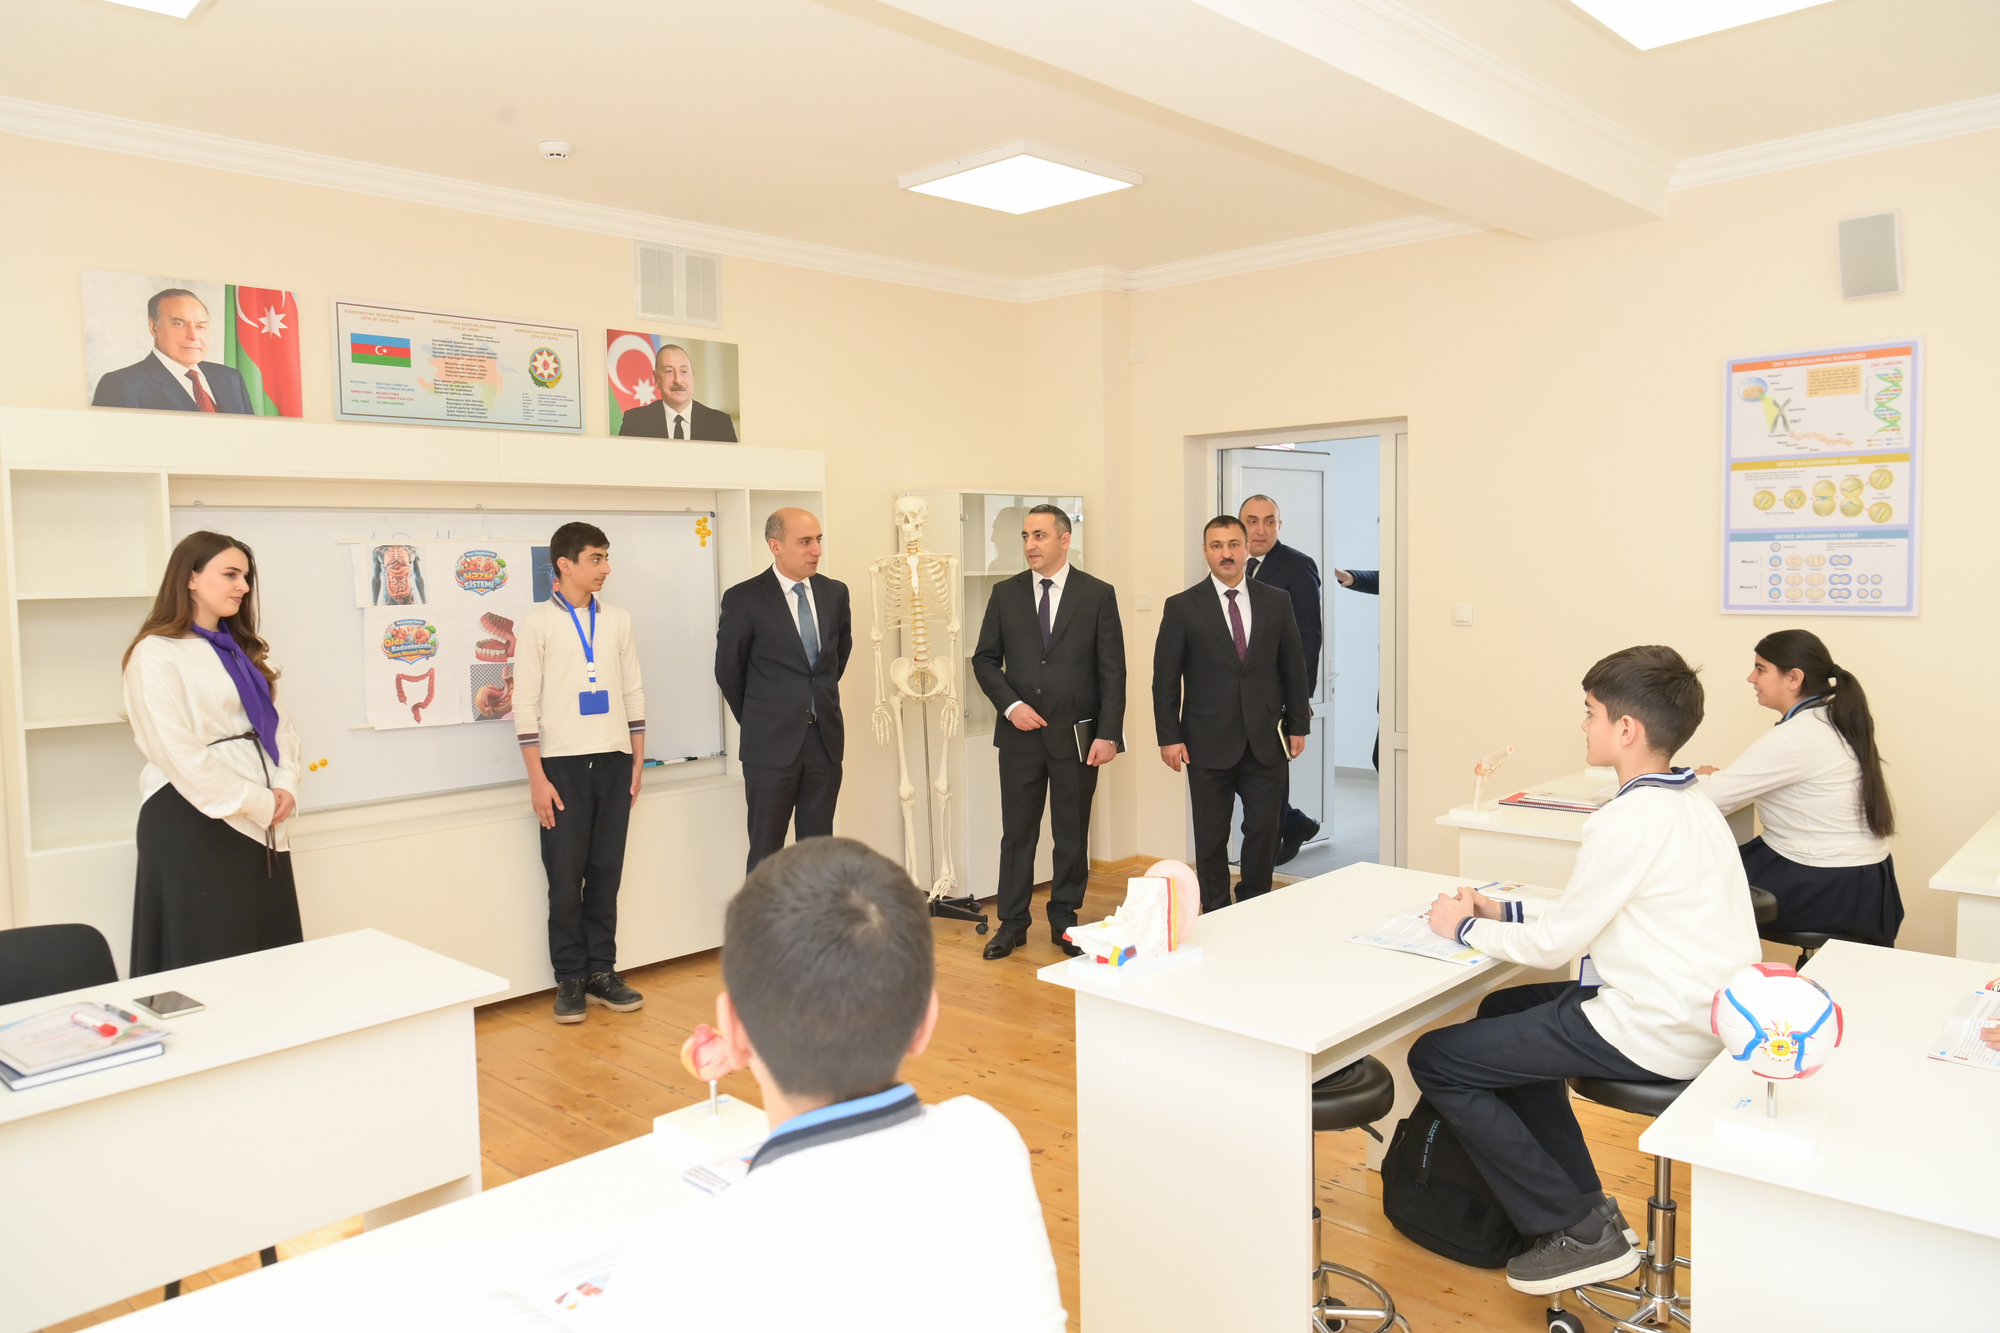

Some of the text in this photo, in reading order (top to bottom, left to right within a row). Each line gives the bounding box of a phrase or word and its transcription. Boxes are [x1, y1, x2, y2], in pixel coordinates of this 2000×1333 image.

[464, 572, 493, 581] HƏZM
[385, 638, 404, 647] Qida
[392, 643, 431, 652] Bədənimizdə
